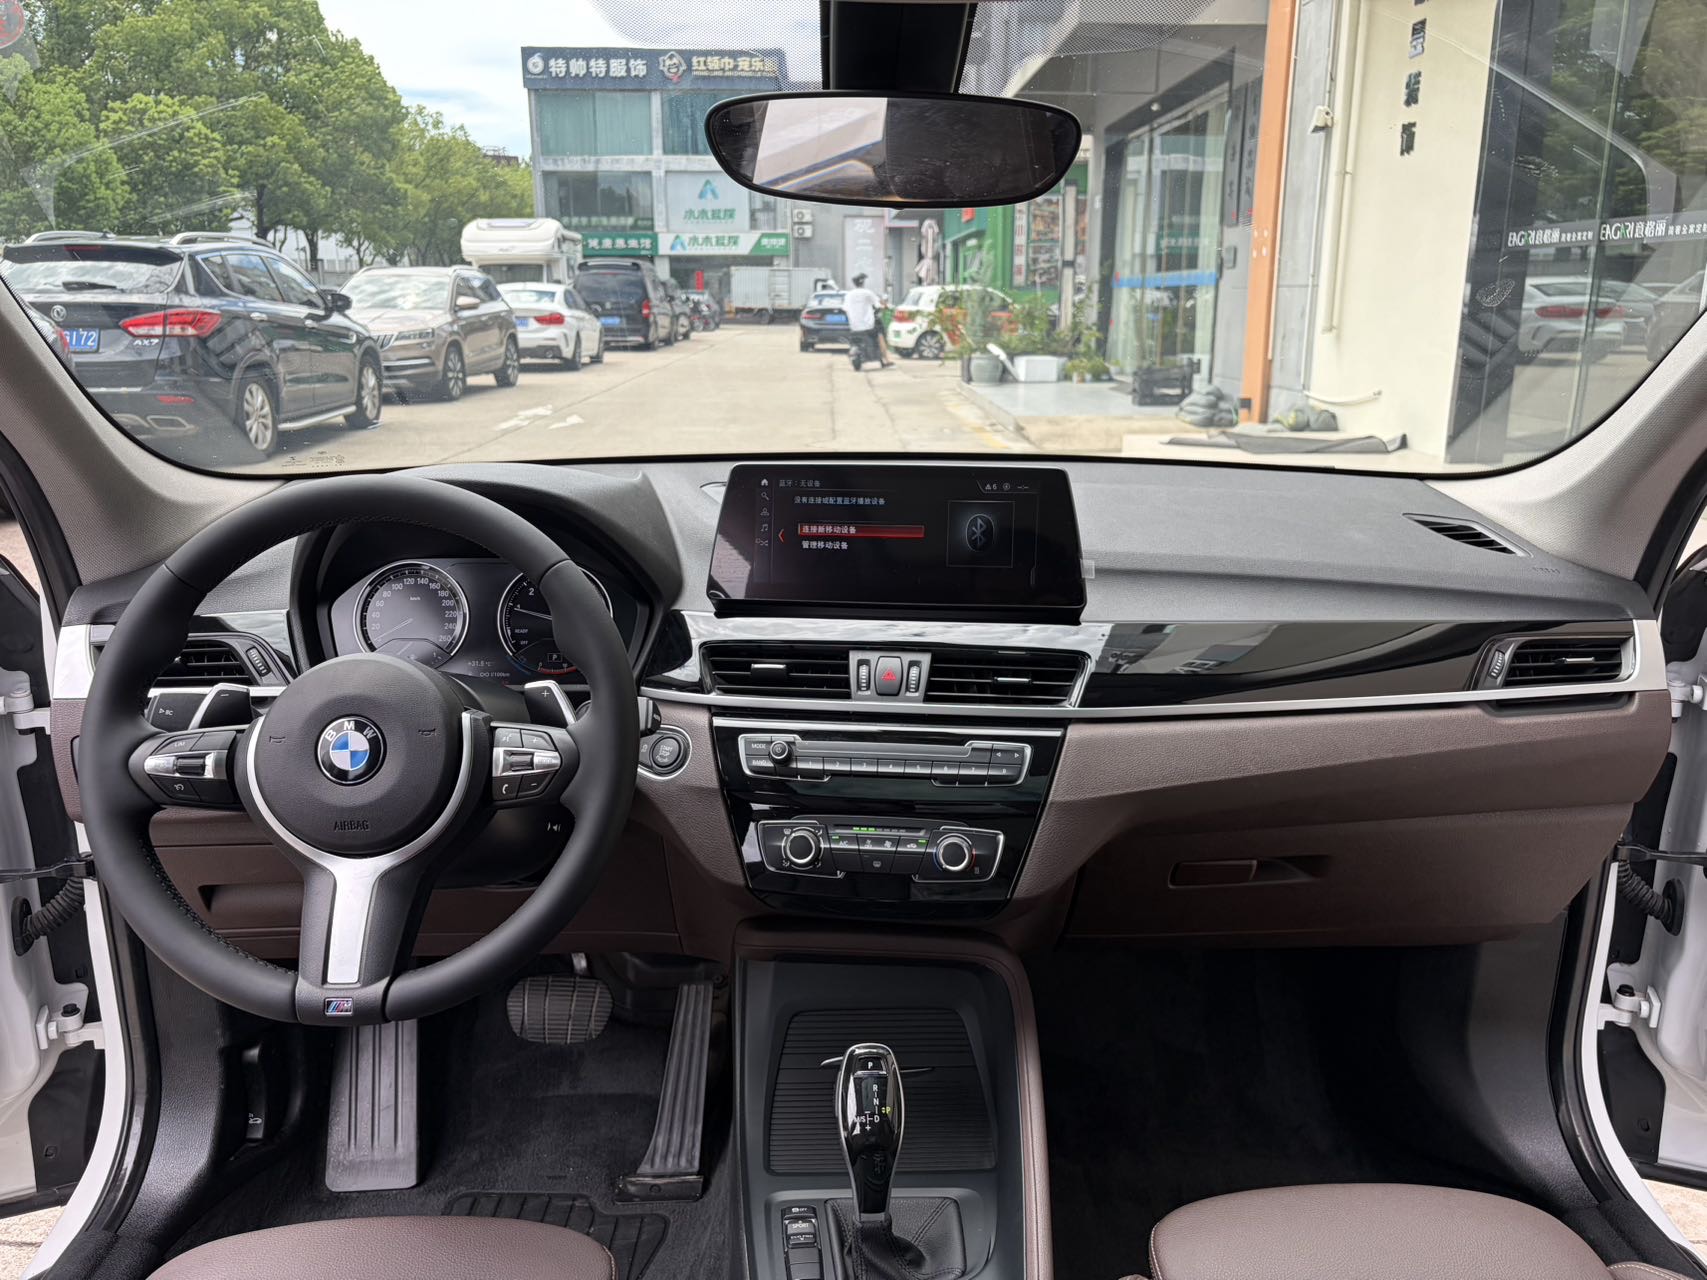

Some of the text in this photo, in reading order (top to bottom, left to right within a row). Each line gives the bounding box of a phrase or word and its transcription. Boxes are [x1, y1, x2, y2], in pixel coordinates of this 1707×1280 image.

[548, 57, 647, 78] 特帅特服饰
[133, 338, 160, 346] AX7
[802, 525, 857, 534] 连接新移动设备
[801, 540, 849, 549] 管理移动设备
[429, 582, 441, 590] 160
[325, 720, 377, 743] BMW
[334, 820, 369, 831] AIRBAG
[868, 1061, 873, 1069] P
[872, 1084, 878, 1092] R
[874, 1115, 880, 1123] D
